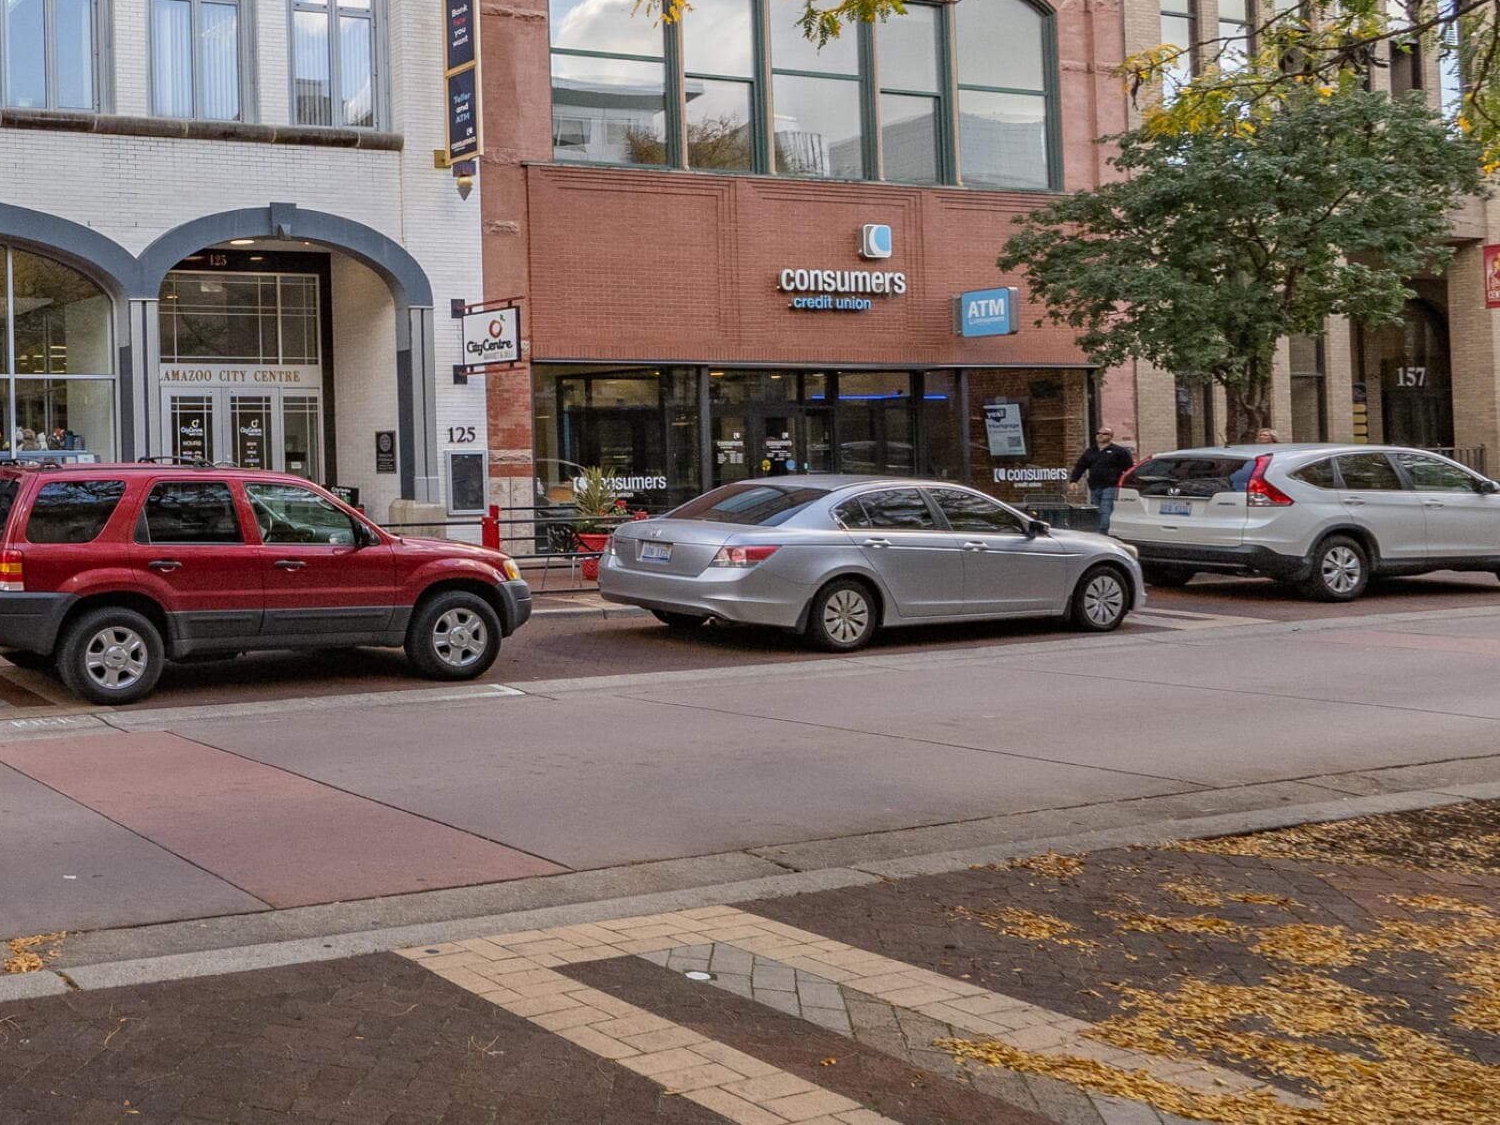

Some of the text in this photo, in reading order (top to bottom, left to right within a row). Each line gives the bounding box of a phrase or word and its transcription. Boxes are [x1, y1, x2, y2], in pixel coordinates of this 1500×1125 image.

[451, 3, 468, 18] Bank
[454, 26, 466, 38] you
[456, 102, 469, 114] and
[780, 268, 907, 294] consumers
[792, 295, 872, 310] credit union
[968, 298, 1005, 319] ATM
[219, 370, 247, 383] CITY
[254, 370, 301, 383] CENTRE
[1396, 367, 1426, 387] 157
[447, 426, 476, 444] 125
[1007, 468, 1068, 481] consumers
[590, 476, 667, 490] onsumers
